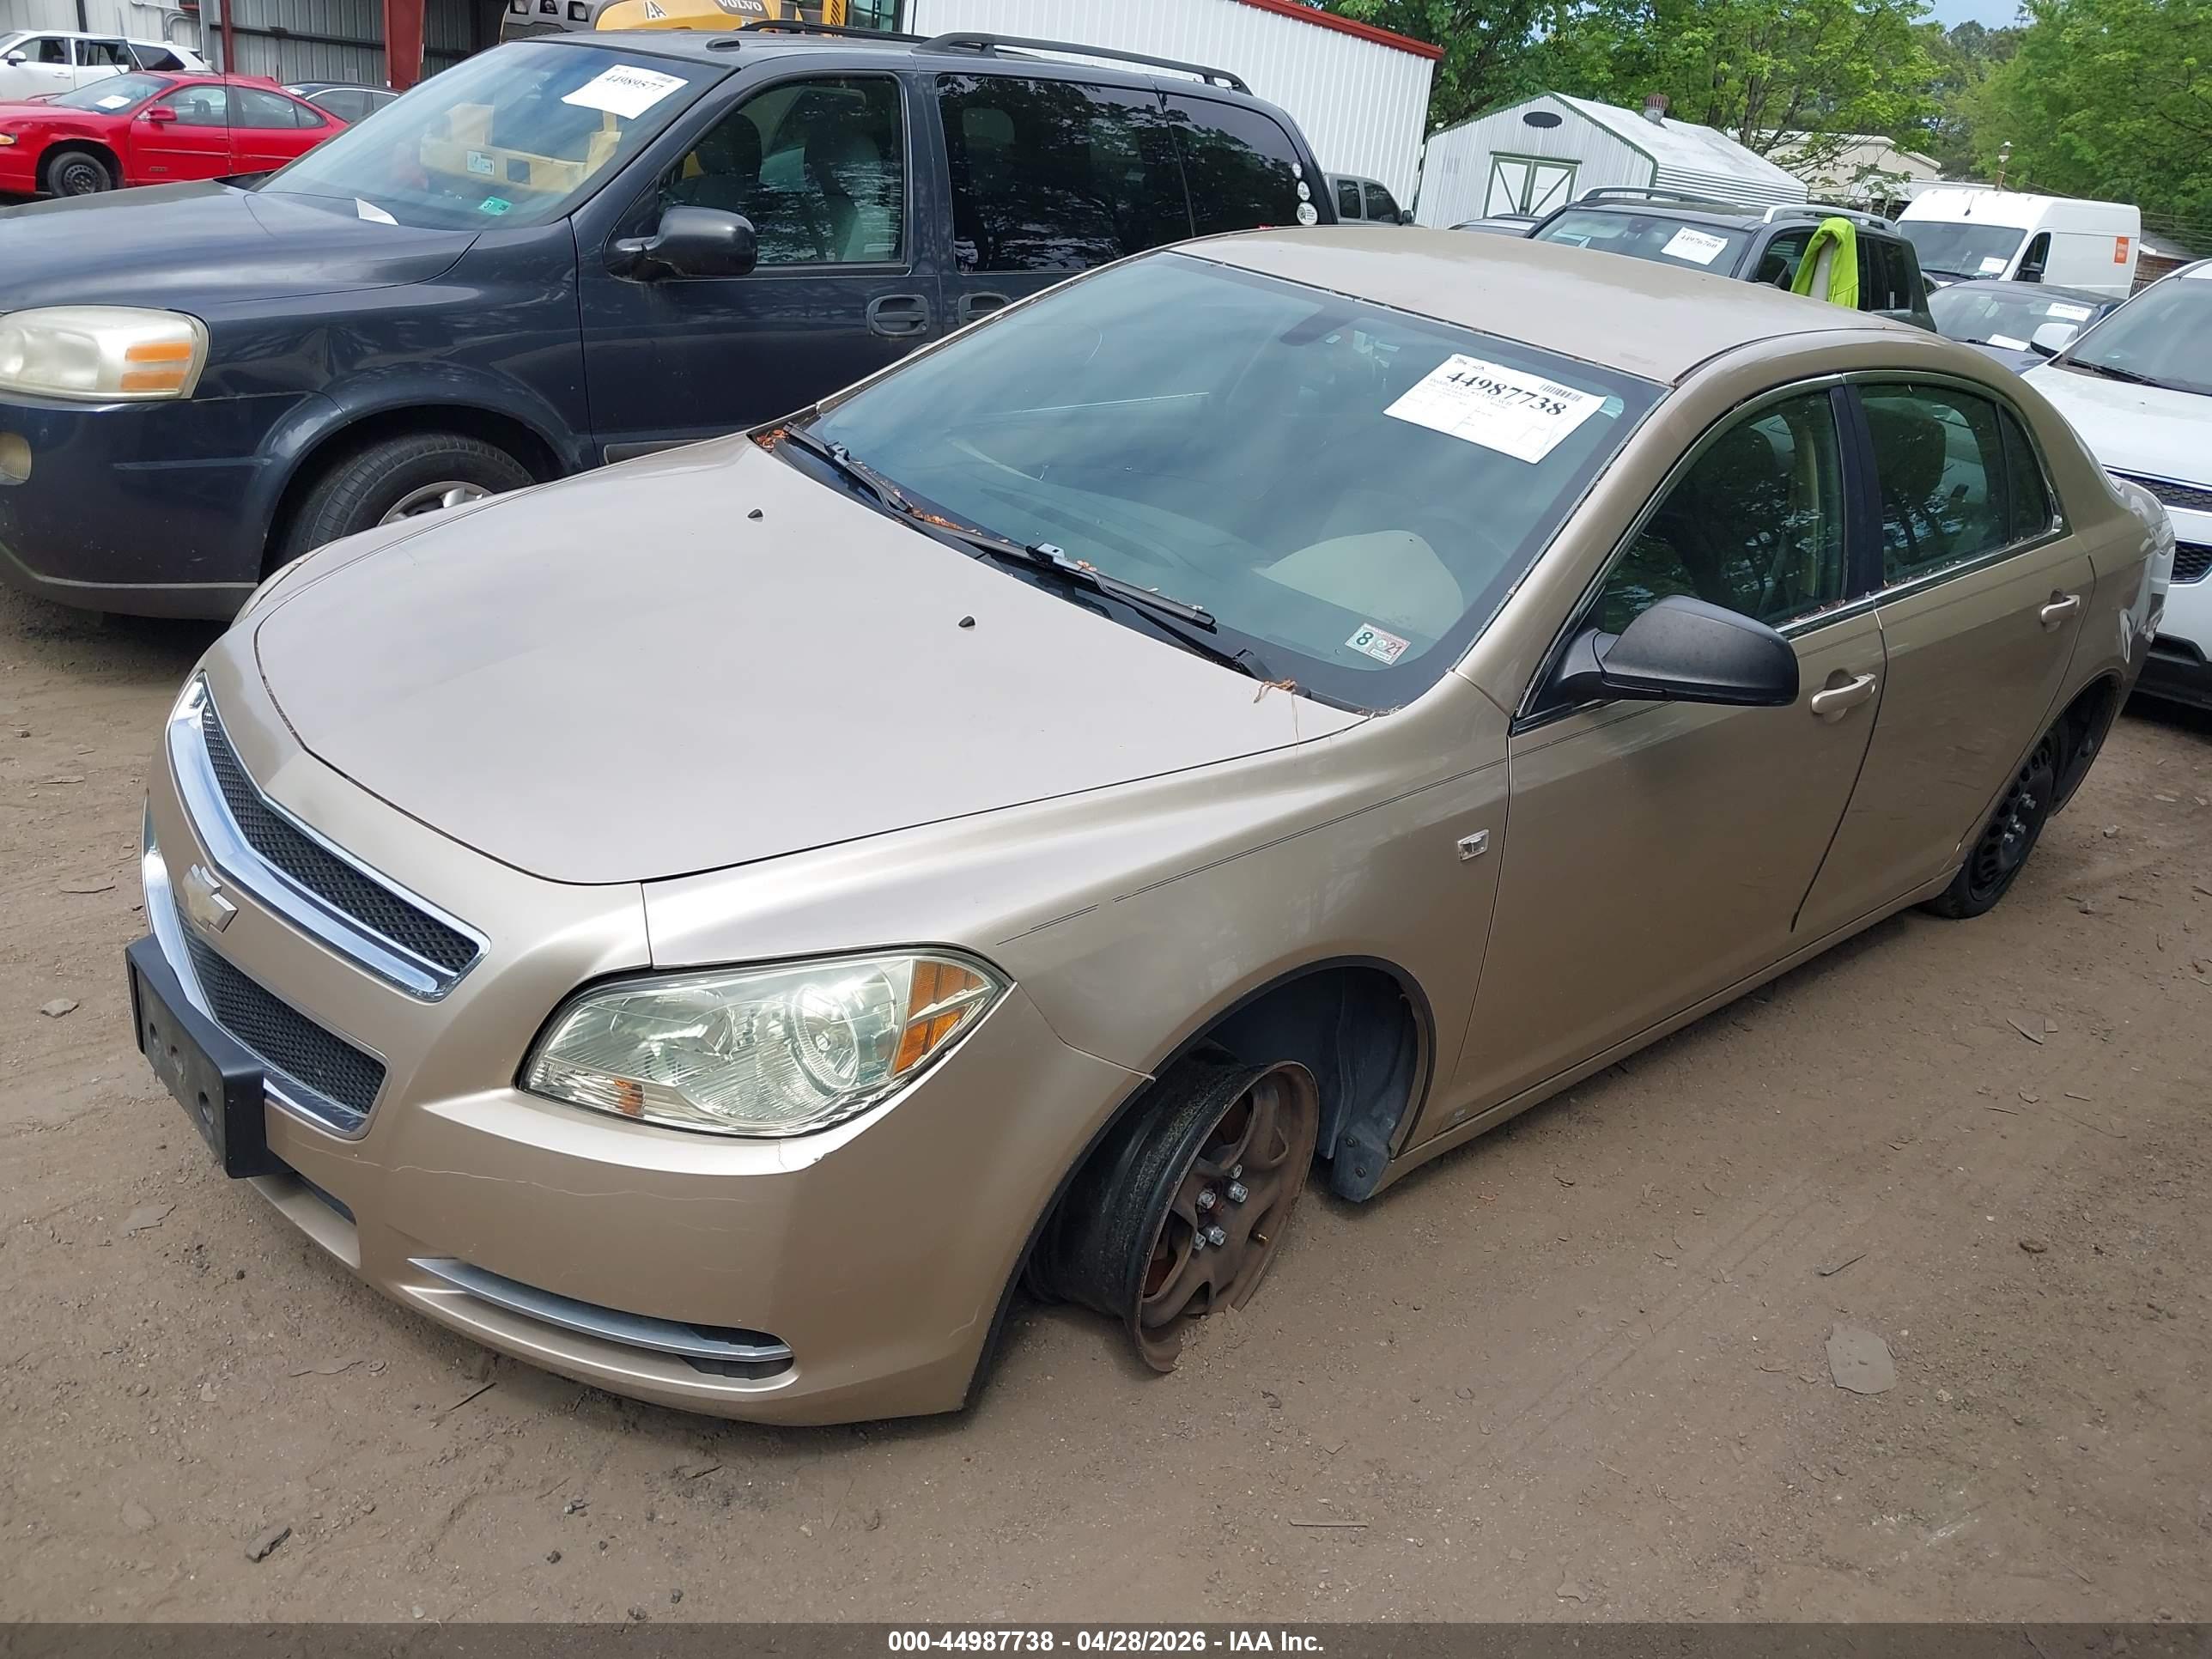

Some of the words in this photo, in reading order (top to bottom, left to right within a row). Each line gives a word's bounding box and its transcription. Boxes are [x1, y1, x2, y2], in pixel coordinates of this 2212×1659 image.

[718, 0, 763, 12] VOLVO
[1446, 371, 1567, 416] 44987738
[1356, 631, 1374, 646] 8
[1384, 641, 1403, 655] 21
